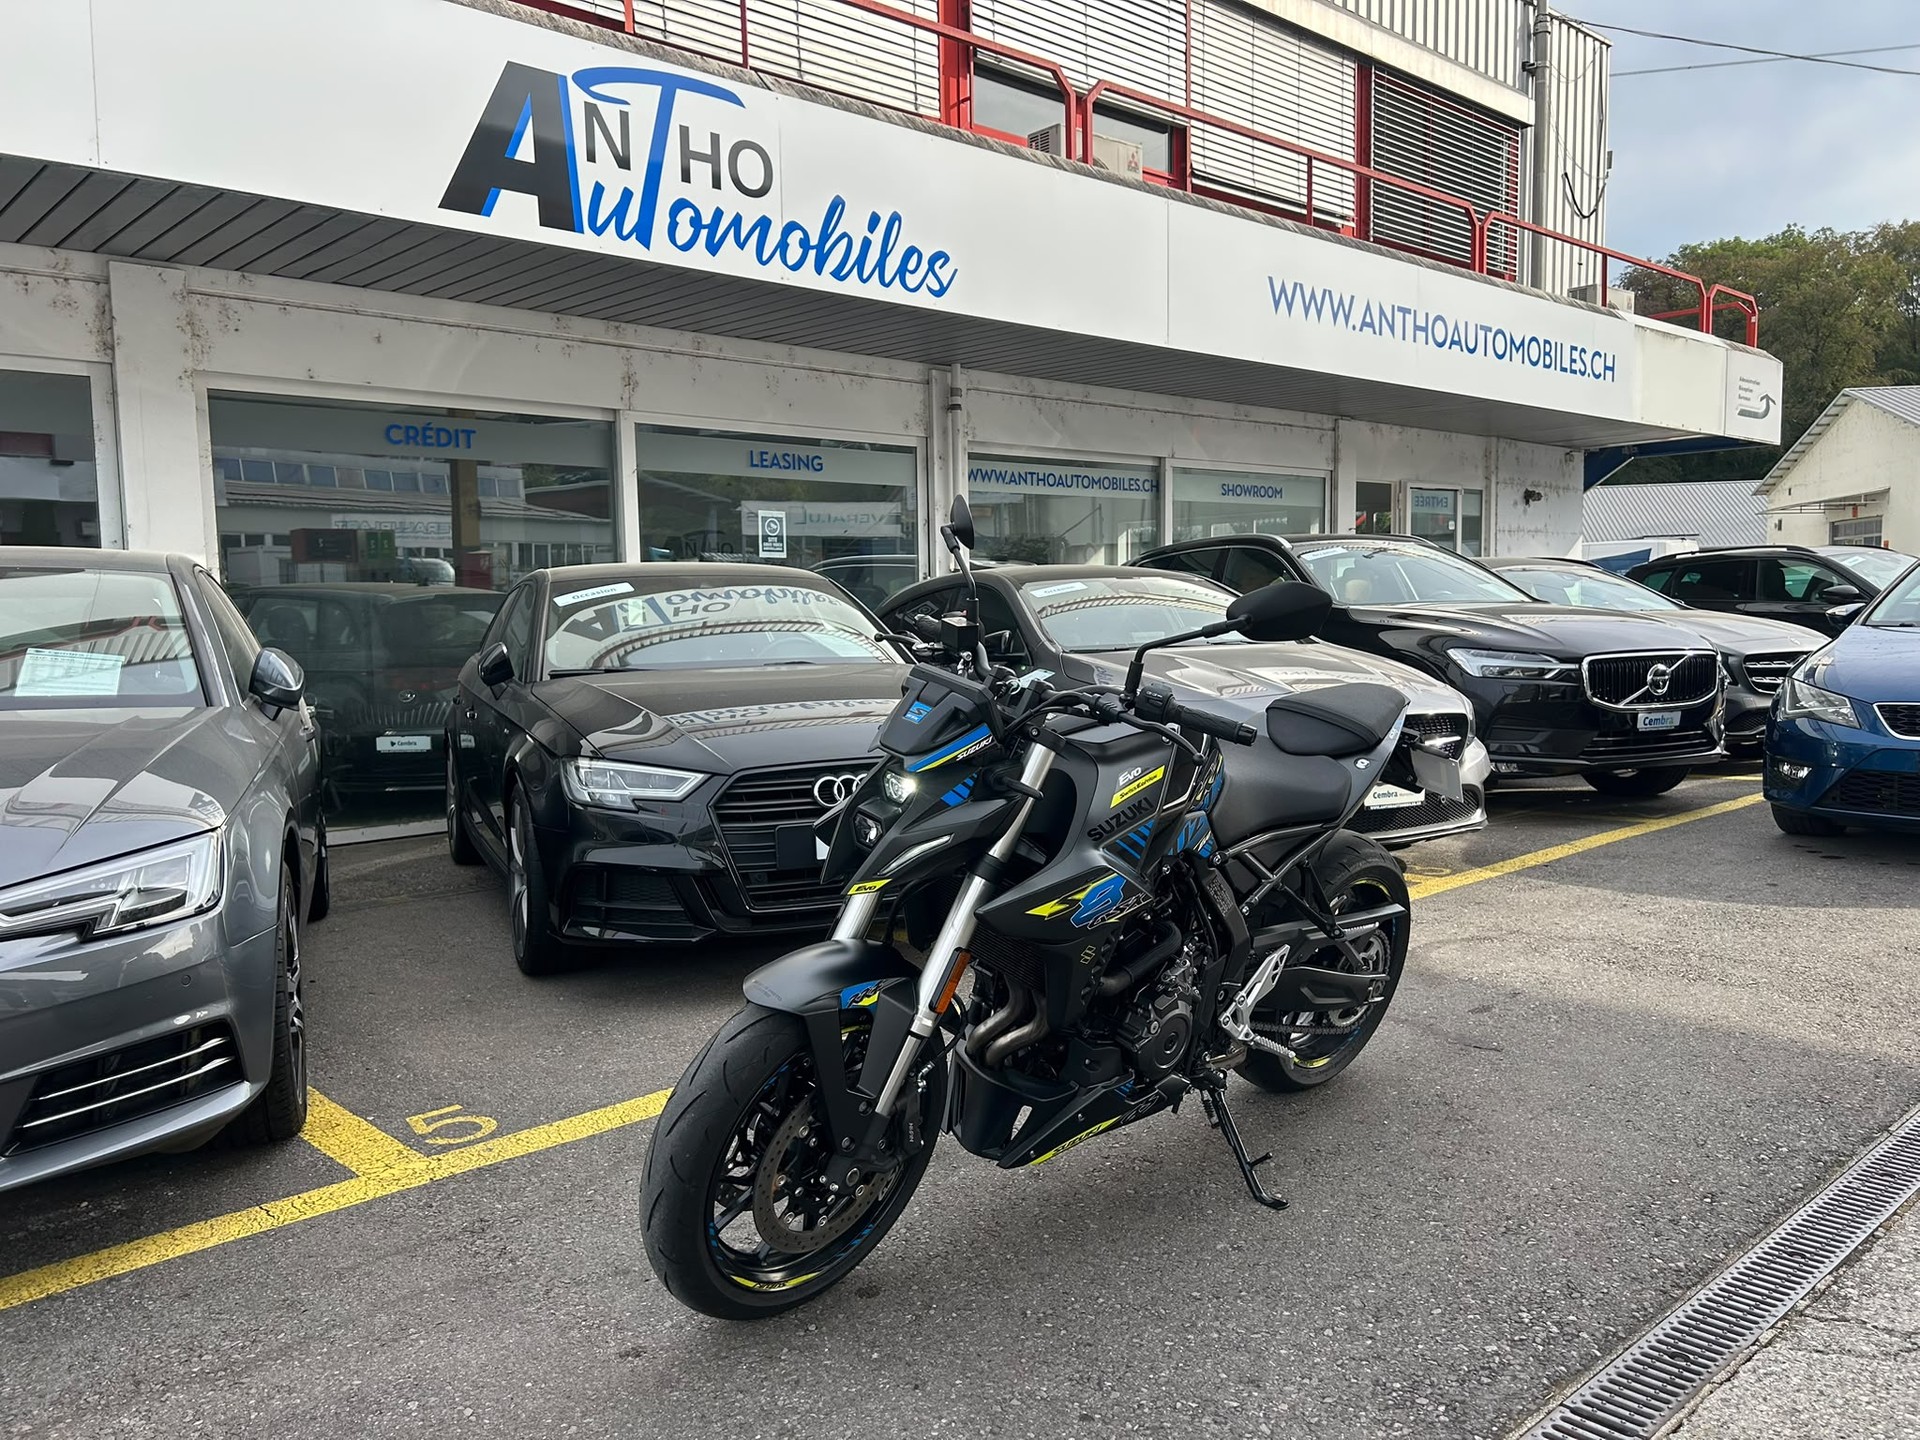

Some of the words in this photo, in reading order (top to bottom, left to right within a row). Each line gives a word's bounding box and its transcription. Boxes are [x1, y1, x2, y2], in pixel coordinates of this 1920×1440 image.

[1267, 275, 1616, 383] WWW.ANTHOAUTOMOBILES.CH
[385, 421, 476, 450] CRÉDIT
[750, 450, 824, 472] LEASING
[968, 467, 1160, 494] WWW.ANTHOAUTOMOBILES.CH
[1220, 482, 1283, 500] SHOWROOM
[571, 587, 617, 600] Occasion
[1642, 715, 1675, 727] Cembra
[955, 735, 993, 762] SUZUKI
[1372, 790, 1398, 799] Cembra
[1087, 797, 1155, 842] SUZUKI
[405, 1103, 498, 1145] 5
